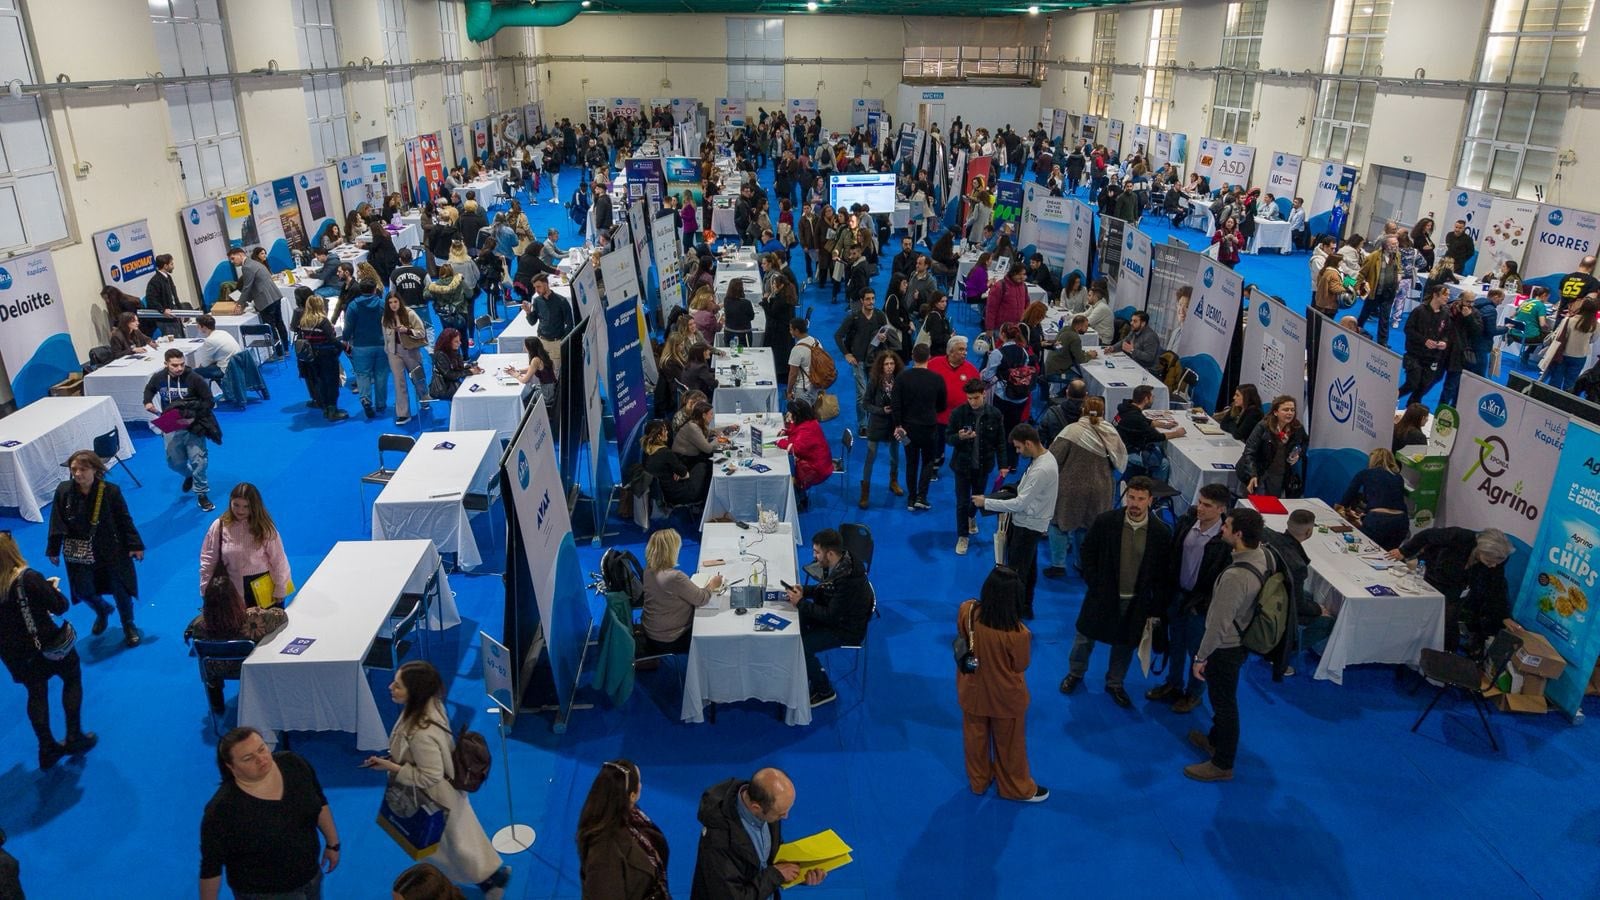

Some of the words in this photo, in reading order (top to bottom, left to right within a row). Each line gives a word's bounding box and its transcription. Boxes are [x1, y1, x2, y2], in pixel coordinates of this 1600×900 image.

[1218, 160, 1246, 175] ASD
[346, 177, 363, 189] DAIKIN
[230, 196, 245, 204] Hertz
[1540, 231, 1589, 253] KORRES
[1126, 257, 1144, 278] ELVAL
[396, 273, 406, 286] NEW
[407, 273, 421, 284] YORK
[1562, 281, 1585, 296] 65
[0, 292, 54, 322] Deloitte.
[1205, 303, 1222, 324] DEMO
[1334, 339, 1349, 354] ΔΥΠΑ
[1366, 361, 1391, 382] Καριέρας
[1480, 400, 1506, 419] ΔΥΠΑ
[1544, 419, 1566, 436] Ημέρ
[1534, 429, 1564, 451] Καριέρ
[1490, 455, 1509, 470] ΧΡΟΝΙΑ
[1583, 457, 1600, 475] Ag
[1477, 477, 1538, 520] Agrino
[1567, 482, 1579, 502] IT'S
[1571, 533, 1593, 549] Agrino
[1565, 542, 1591, 562] RICE
[1549, 546, 1599, 587] CHIPS
